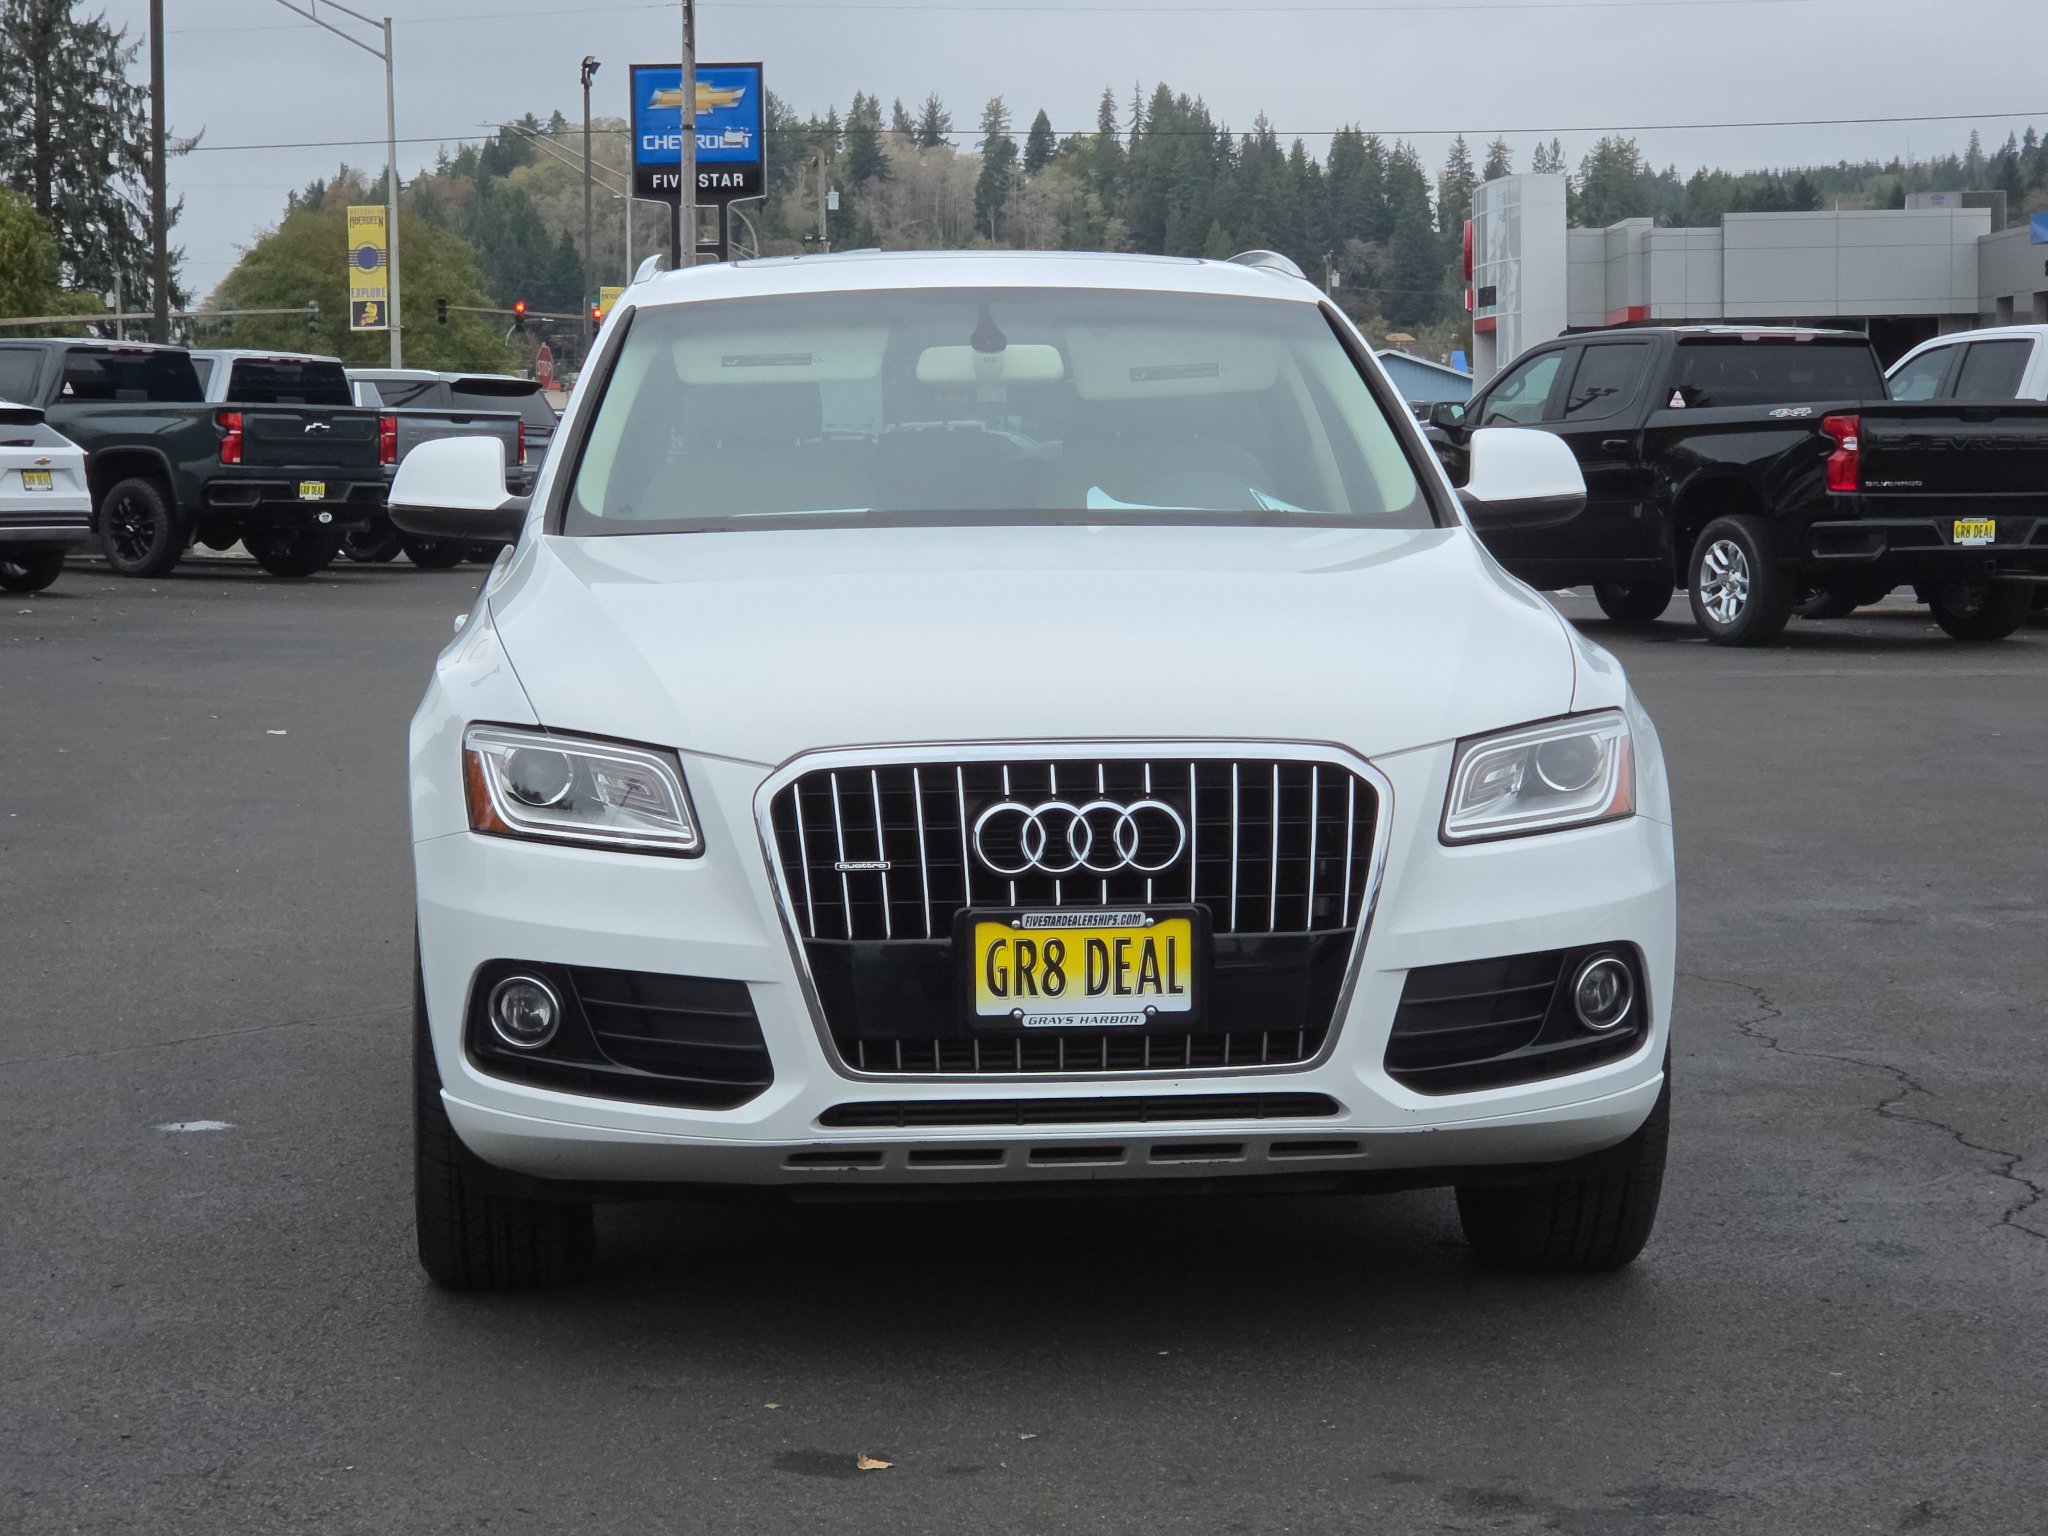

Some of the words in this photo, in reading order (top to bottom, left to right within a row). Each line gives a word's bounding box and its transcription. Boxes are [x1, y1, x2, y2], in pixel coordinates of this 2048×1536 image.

[642, 134, 752, 150] CHEROLT
[652, 174, 684, 188] FIV
[698, 173, 744, 188] STAR
[349, 216, 384, 229] ABERDEEN
[351, 287, 386, 299] EXPLORE
[537, 360, 552, 377] STOP
[1955, 524, 1971, 539] GR8
[1973, 524, 1993, 539] DEAL
[1025, 913, 1142, 927] FIVESTARDEALERSHIPS.COM
[985, 936, 1067, 998] GR8
[1083, 935, 1185, 998] DEAL
[1028, 1015, 1074, 1025] GRAYS
[1079, 1014, 1140, 1025] HARBOR
